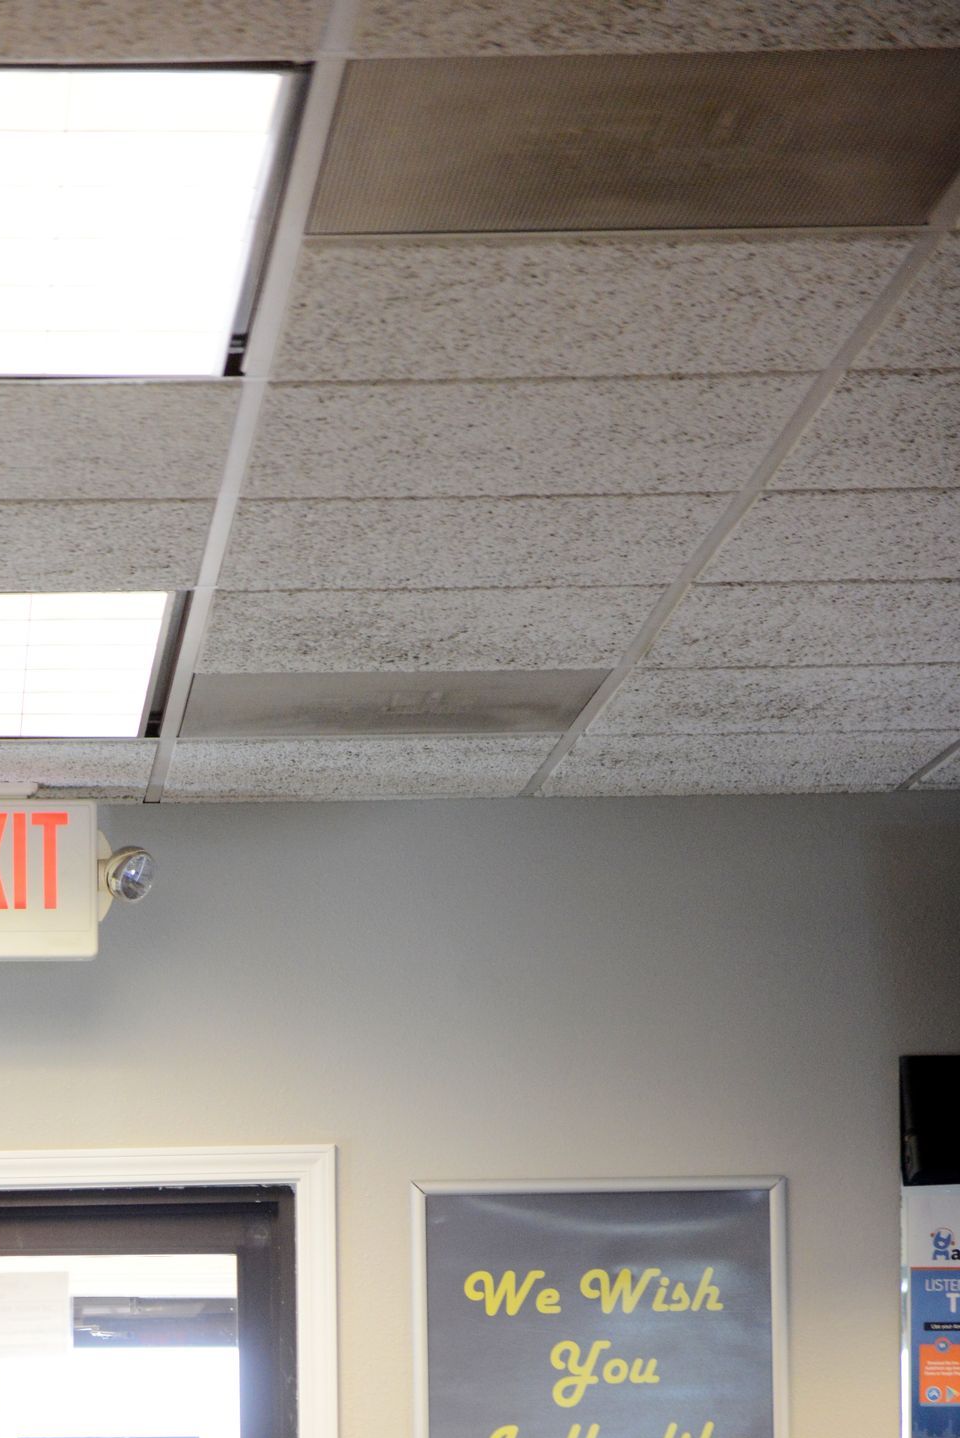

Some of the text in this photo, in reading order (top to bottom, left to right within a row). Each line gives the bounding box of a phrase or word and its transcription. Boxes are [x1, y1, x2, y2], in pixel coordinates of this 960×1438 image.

[464, 1267, 724, 1316] We Wish
[550, 1340, 660, 1408] You
